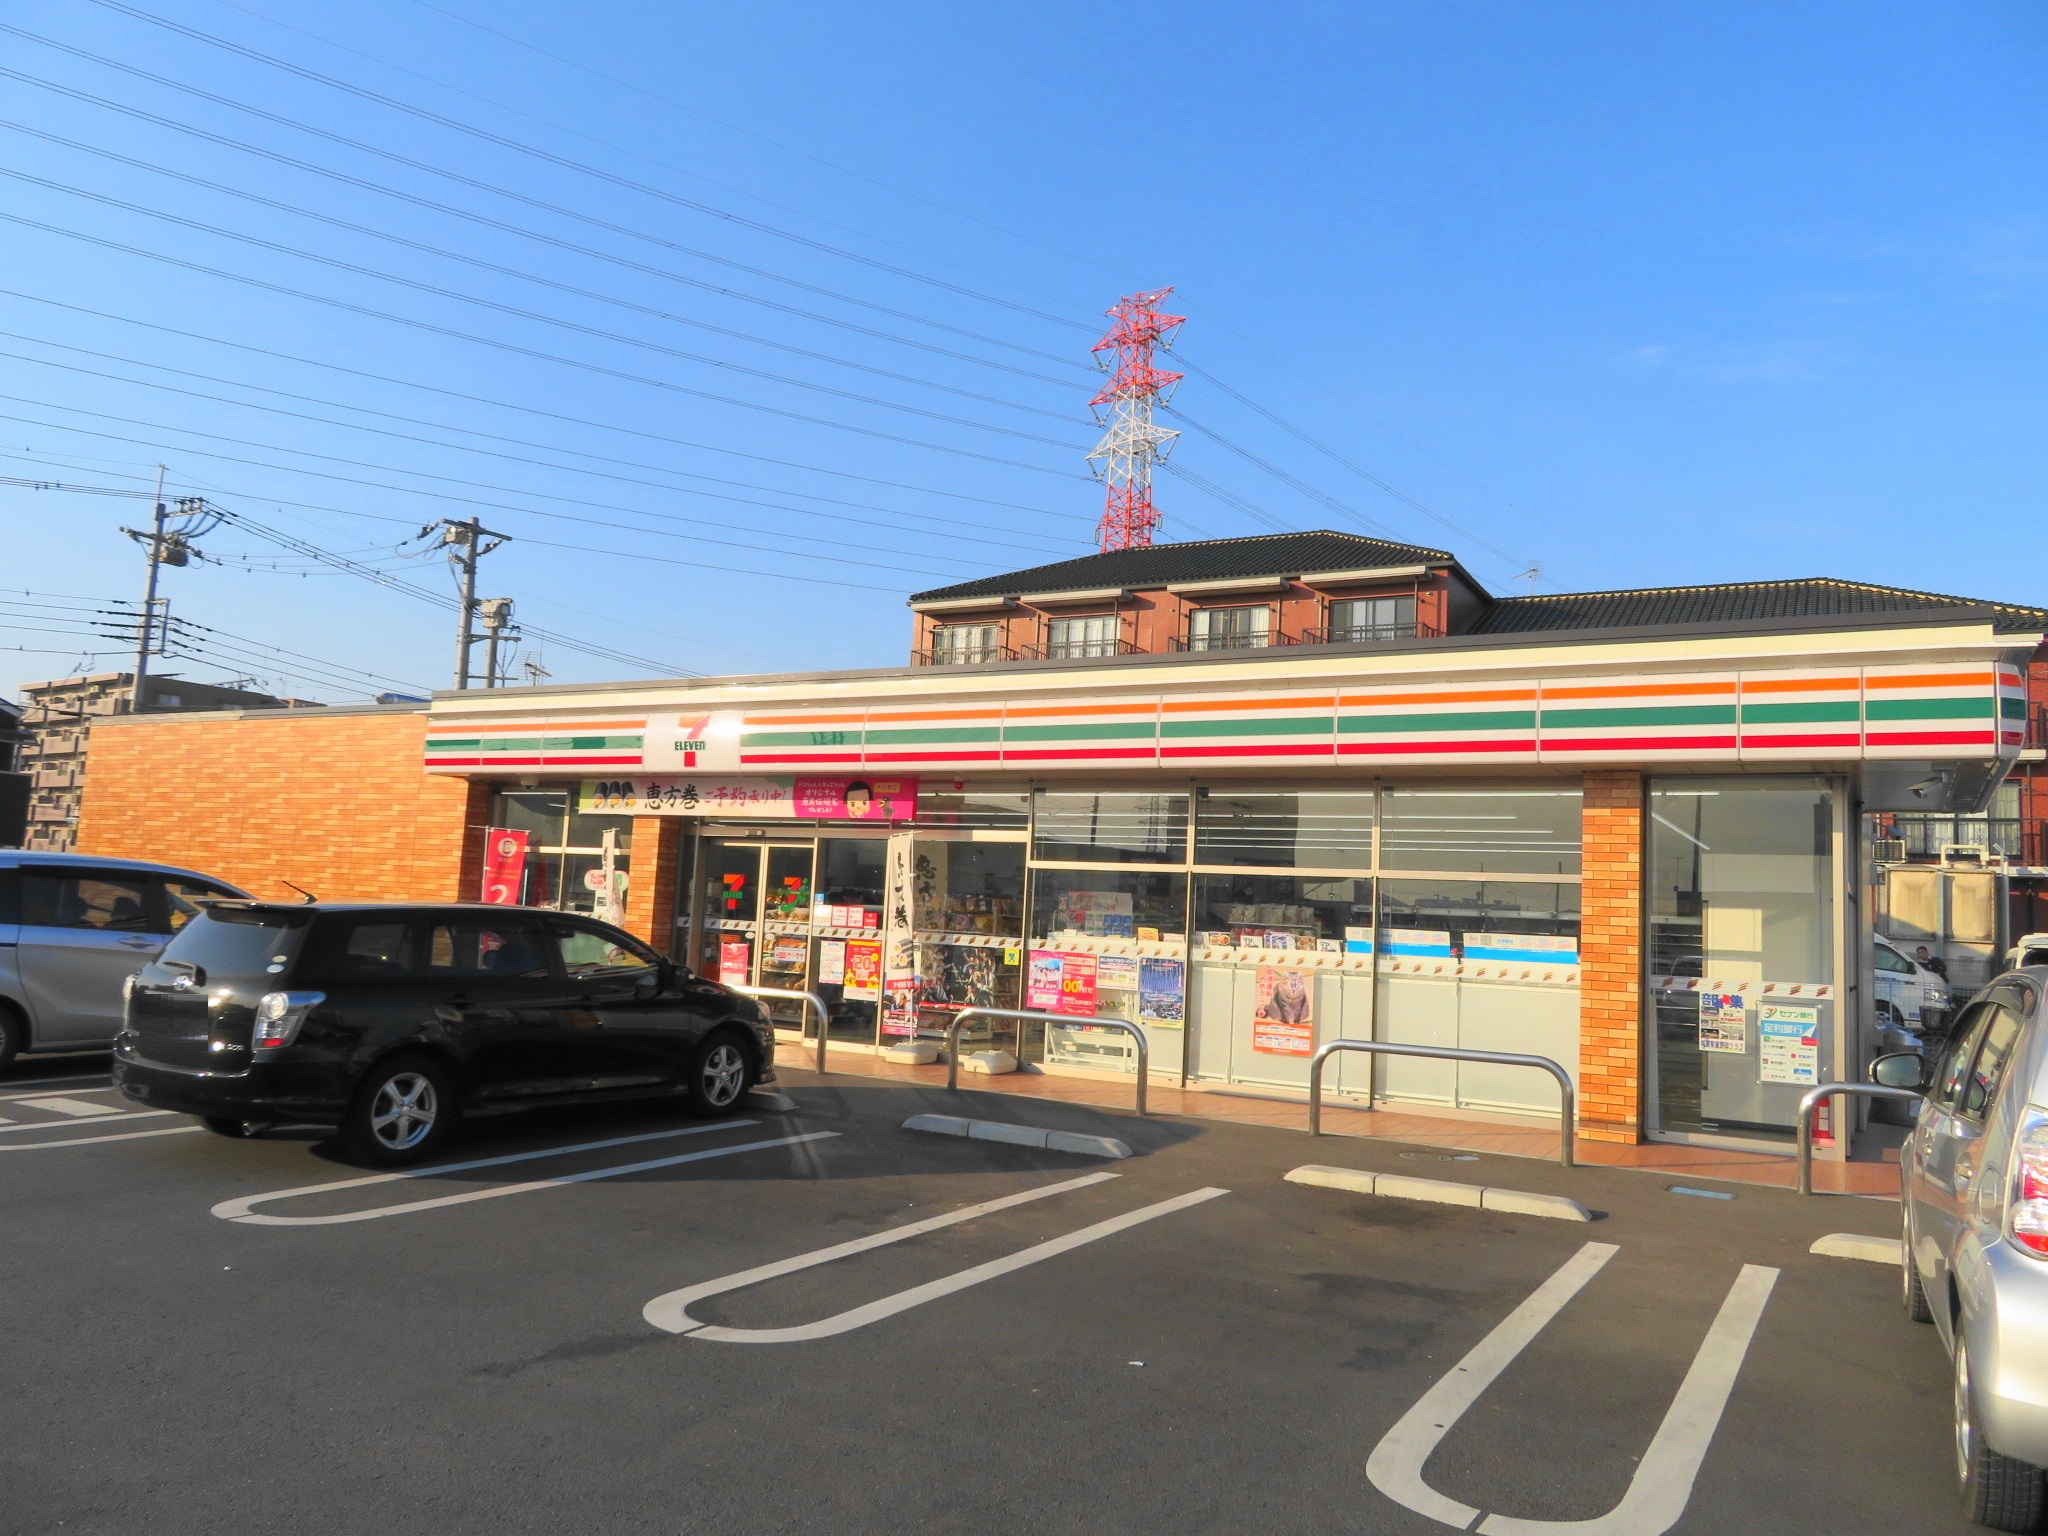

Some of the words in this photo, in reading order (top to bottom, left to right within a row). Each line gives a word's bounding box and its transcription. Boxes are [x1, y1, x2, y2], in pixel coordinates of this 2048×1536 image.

[645, 782, 700, 810] 恵方巻
[1780, 1010, 1813, 1019] セブン銀行
[1764, 1023, 1803, 1035] 足利銀行
